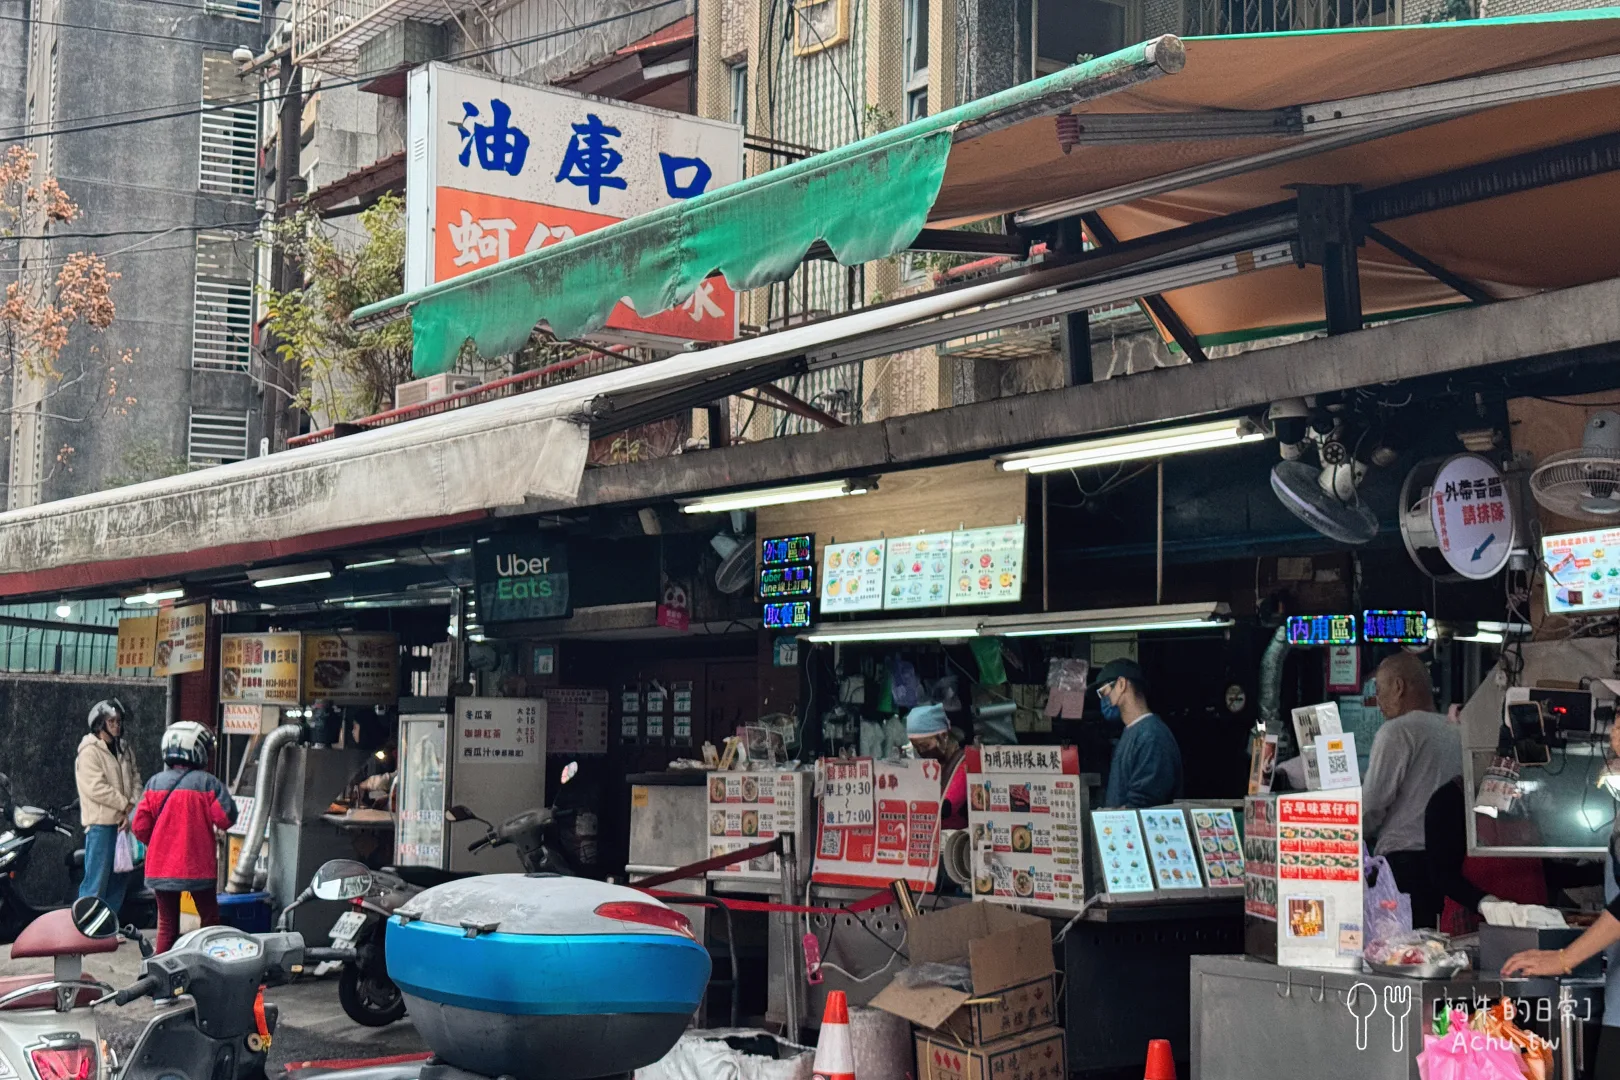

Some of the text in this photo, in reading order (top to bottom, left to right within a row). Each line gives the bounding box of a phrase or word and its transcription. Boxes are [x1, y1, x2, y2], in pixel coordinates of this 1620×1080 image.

[458, 99, 712, 206] 油庫口
[1462, 501, 1506, 526] 請排隊
[766, 541, 799, 560] 外帶區
[496, 553, 550, 576] Uber
[498, 576, 553, 600] Eats
[767, 605, 806, 624] 取餐區
[1292, 618, 1351, 640] 內用區
[465, 710, 492, 720] 冬瓜茶
[526, 706, 536, 716] 25
[526, 717, 536, 725] 15
[826, 763, 870, 781] 營業時間
[826, 781, 871, 797] 早上9:30
[826, 809, 872, 825] 晚上7:00
[1282, 801, 1358, 817] 古早味草仔粿
